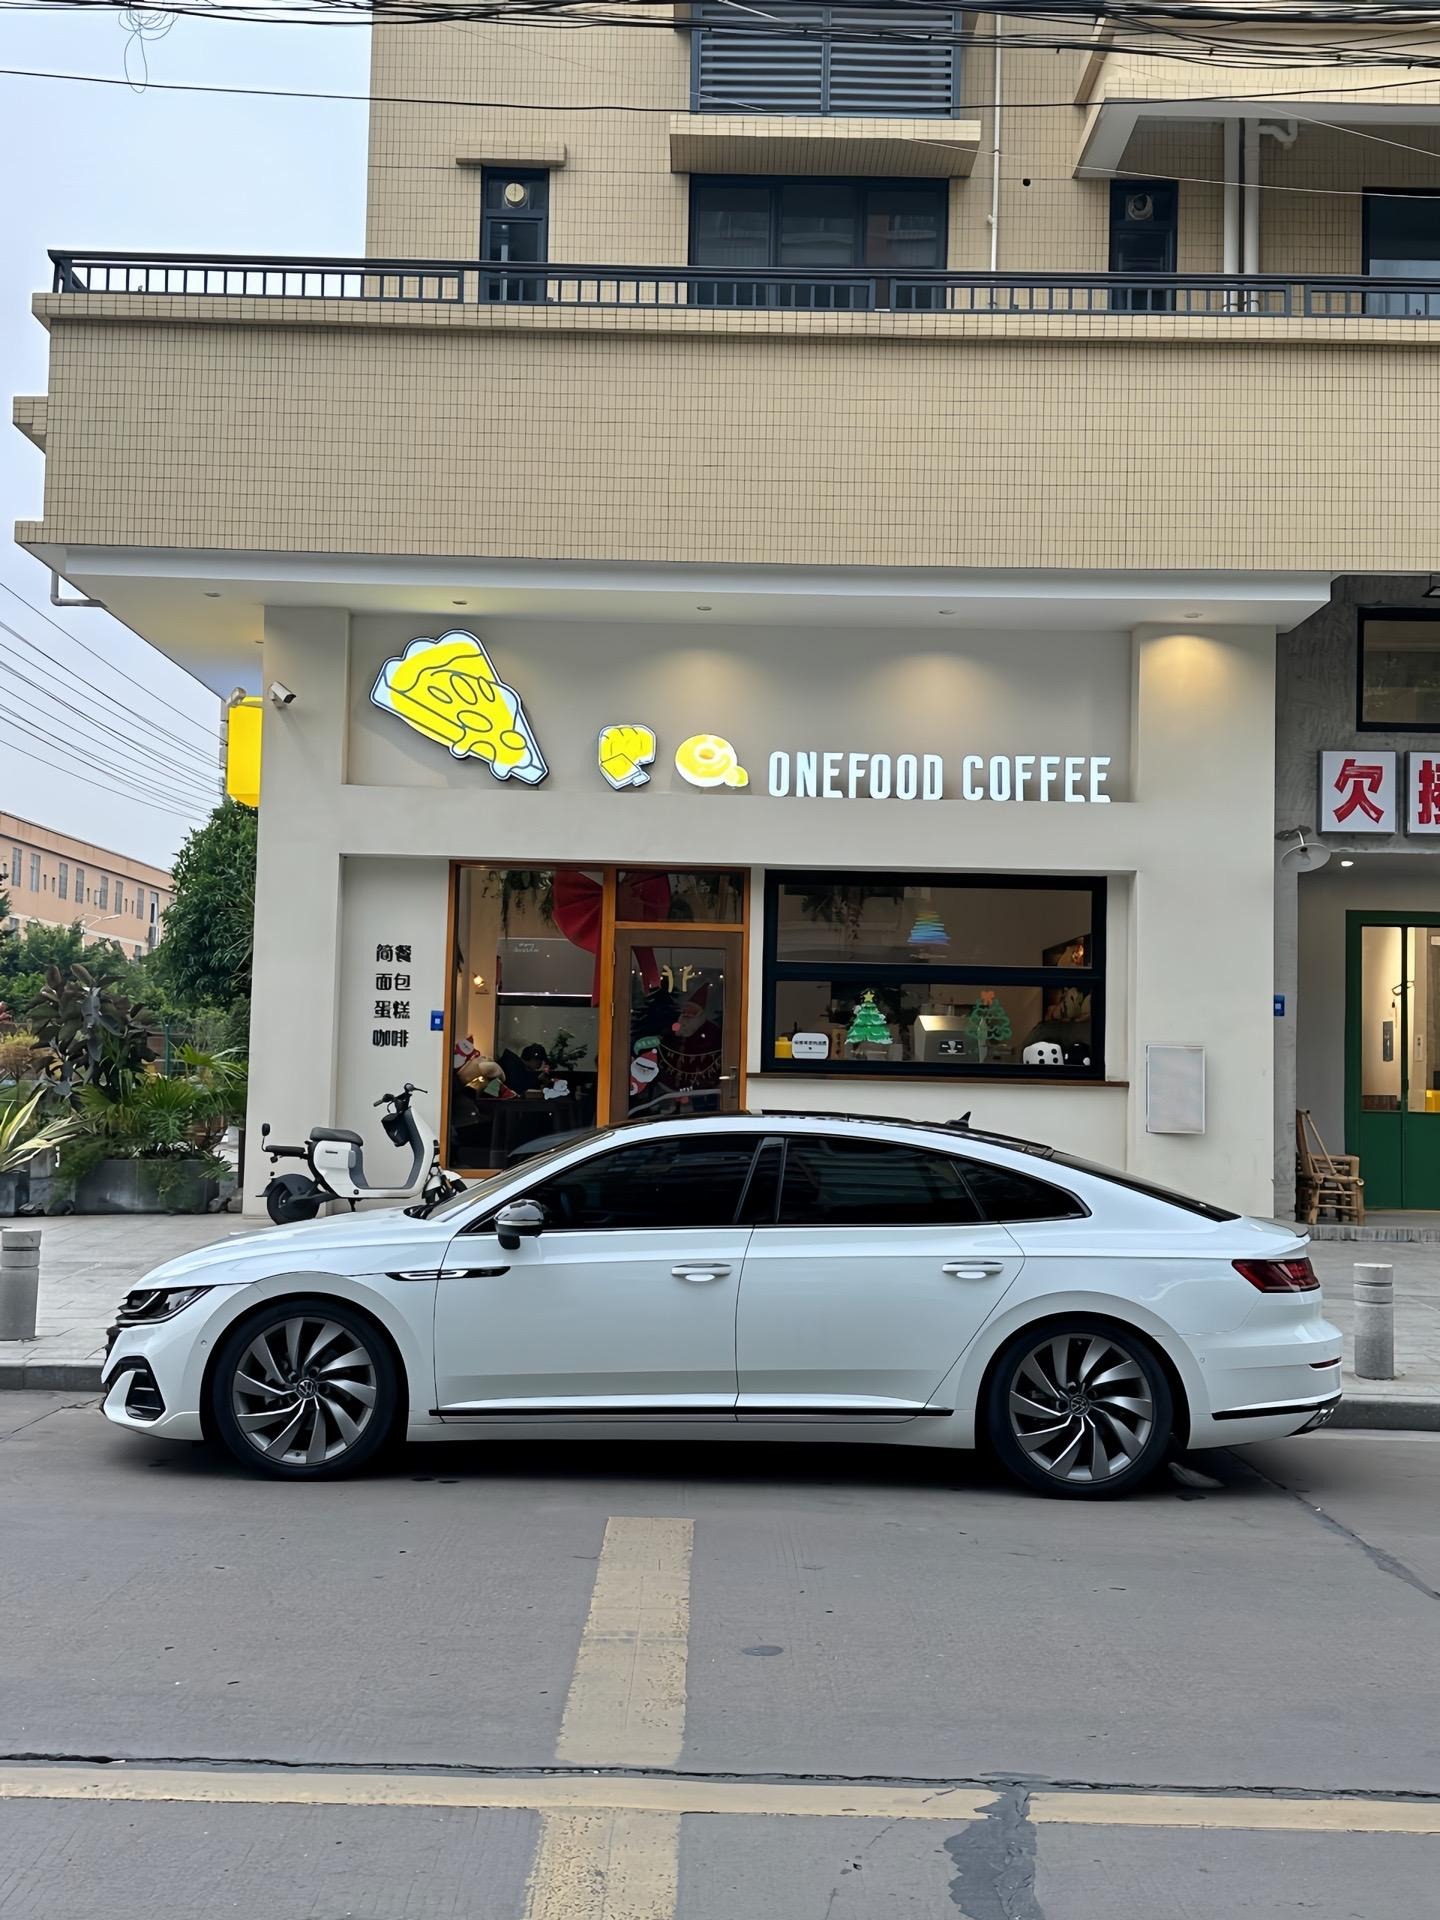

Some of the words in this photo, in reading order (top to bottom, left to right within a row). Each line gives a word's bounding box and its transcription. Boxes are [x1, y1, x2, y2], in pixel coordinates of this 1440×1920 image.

[768, 751, 943, 801] ONEFOOD
[962, 755, 1111, 803] COFFEE
[376, 943, 412, 963] 简餐
[375, 972, 411, 991] 面包
[373, 1000, 411, 1020] 蛋糕
[372, 1028, 409, 1048] 咖啡
